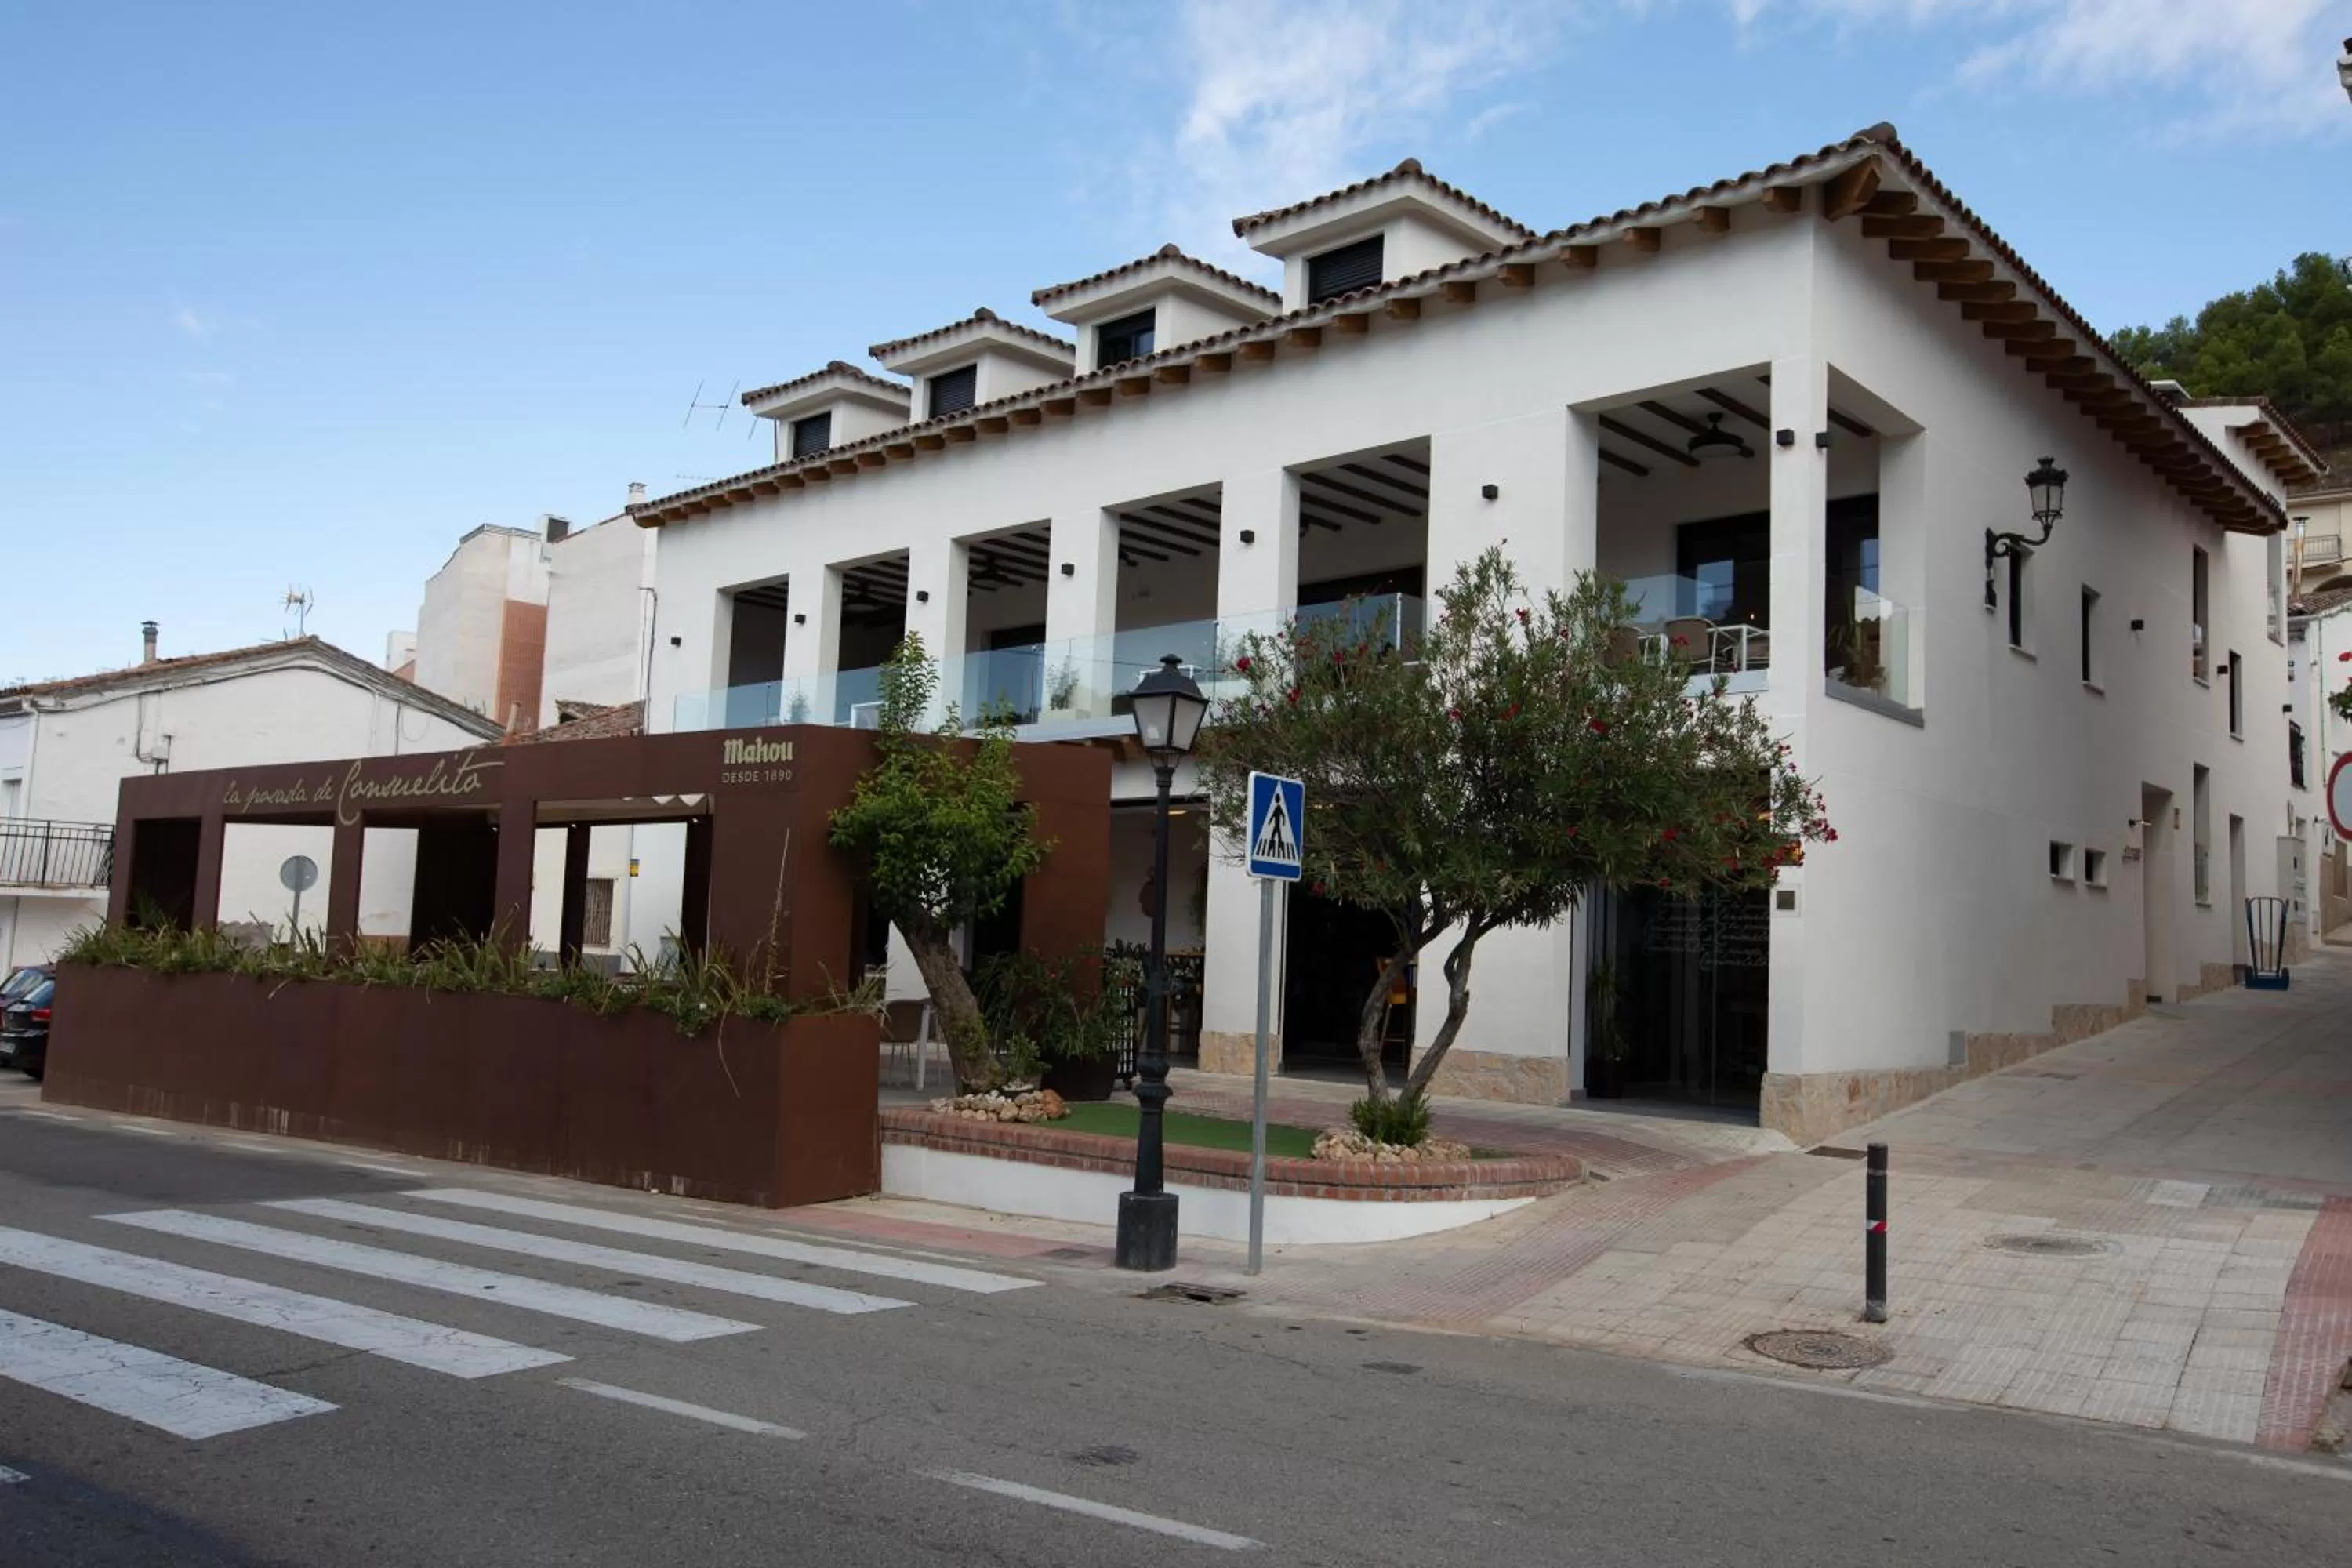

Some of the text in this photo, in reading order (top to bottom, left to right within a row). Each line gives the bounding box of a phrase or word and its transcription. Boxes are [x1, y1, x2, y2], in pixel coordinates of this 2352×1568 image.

[724, 735, 793, 765] Mahou
[241, 777, 308, 813] posada
[314, 775, 335, 803] de
[339, 750, 506, 827] Consuelito
[721, 768, 793, 783] DESDE 1890
